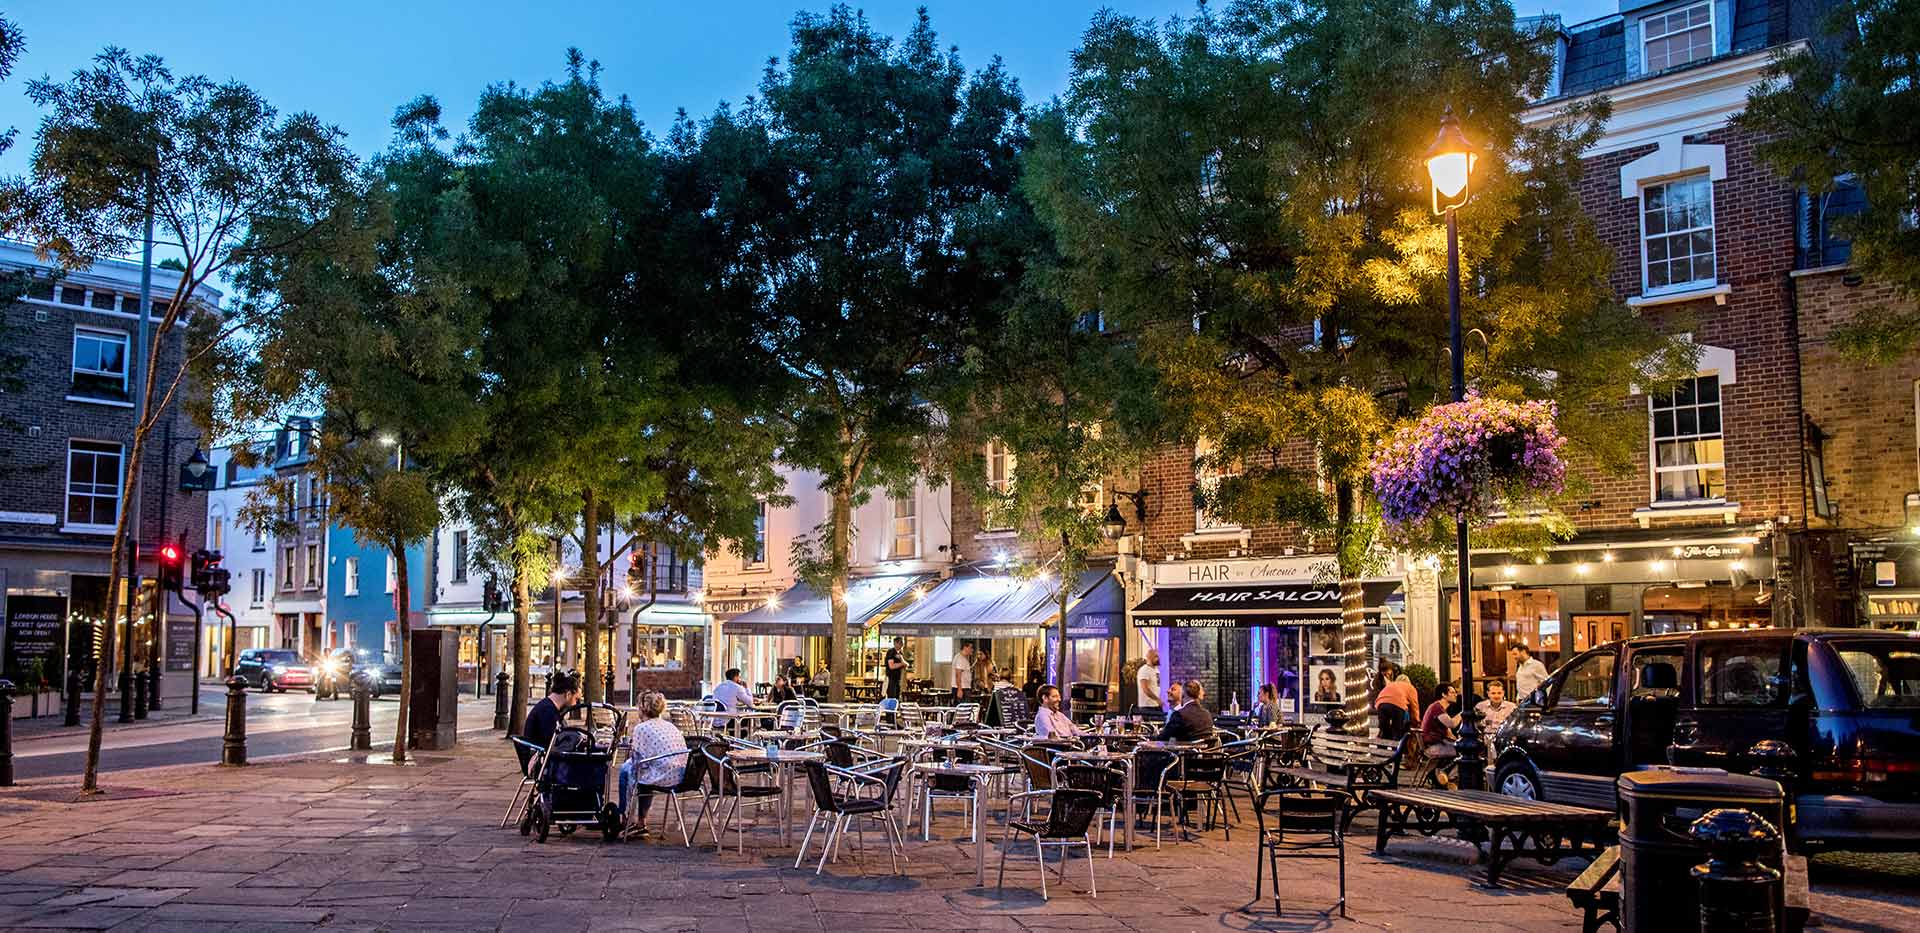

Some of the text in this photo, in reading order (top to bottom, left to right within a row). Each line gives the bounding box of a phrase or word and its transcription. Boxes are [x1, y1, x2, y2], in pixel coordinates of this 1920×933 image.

[1188, 565, 1230, 581] HAIR
[1249, 563, 1297, 577] Antonio
[1190, 589, 1342, 602] HAIR SALON
[1176, 619, 1189, 627] Tel:
[1190, 619, 1236, 627] 02072237111
